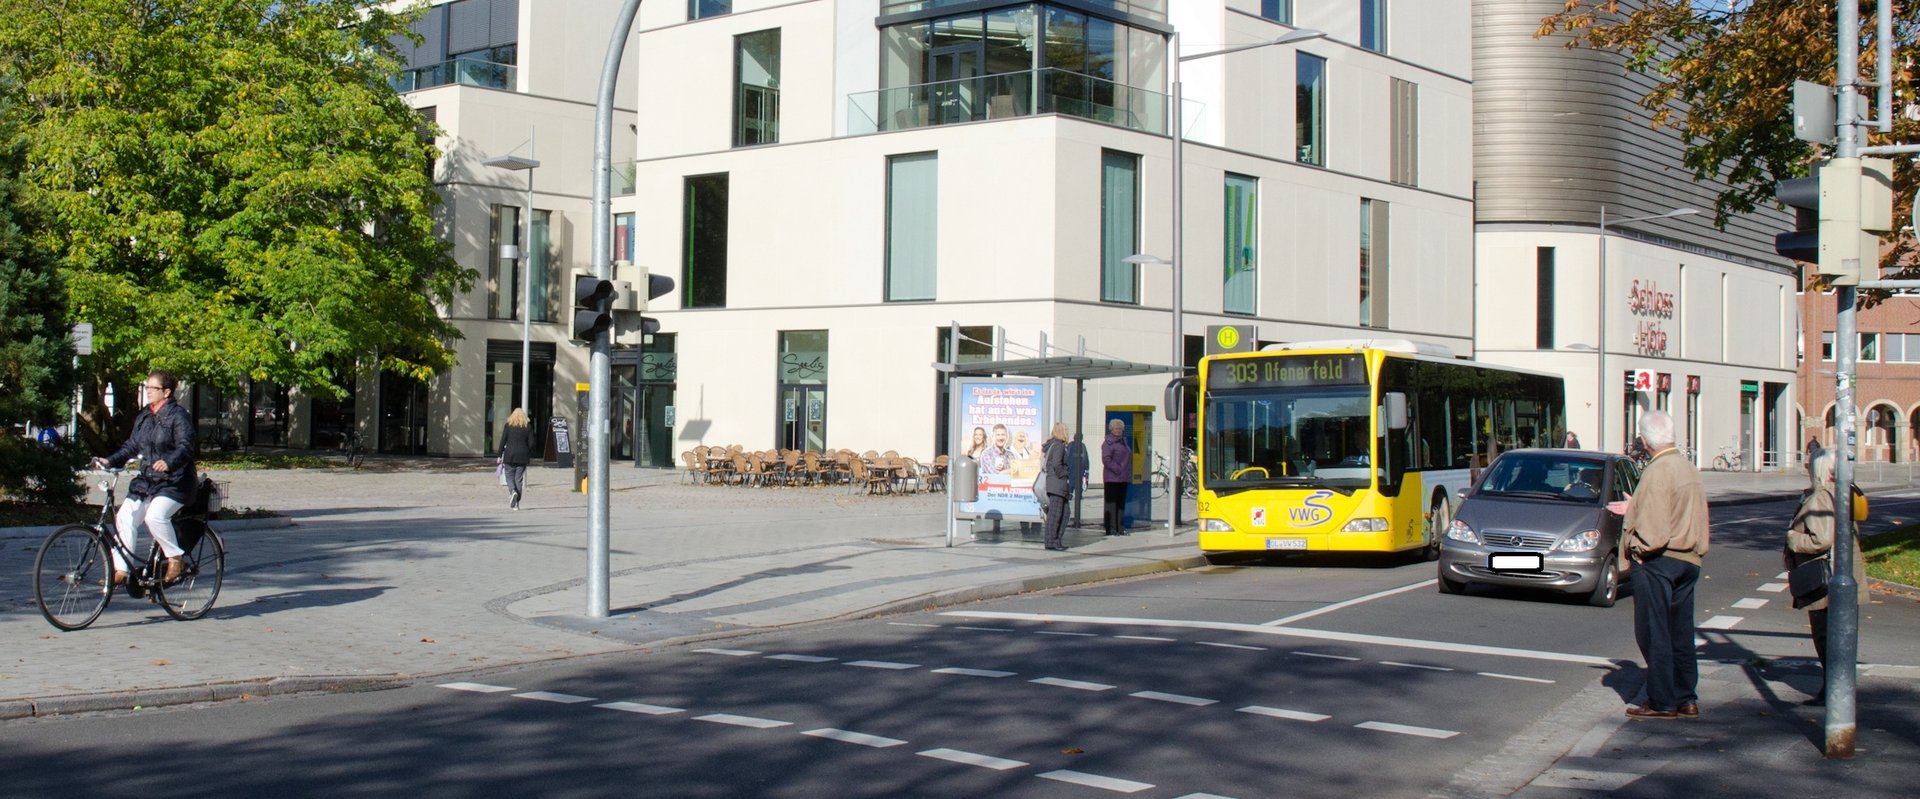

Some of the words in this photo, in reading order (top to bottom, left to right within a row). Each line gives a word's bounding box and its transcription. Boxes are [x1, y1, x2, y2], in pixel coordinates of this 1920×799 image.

[1631, 279, 1674, 317] Schloss
[1226, 362, 1258, 383] 303
[1264, 358, 1343, 382] Ofenerfeld
[977, 395, 1028, 406] Aufstehen
[968, 405, 985, 415] hat
[988, 405, 1013, 416] auch
[1015, 407, 1037, 417] was
[972, 416, 1034, 426] Erhebendes.
[1289, 507, 1321, 521] VWG
